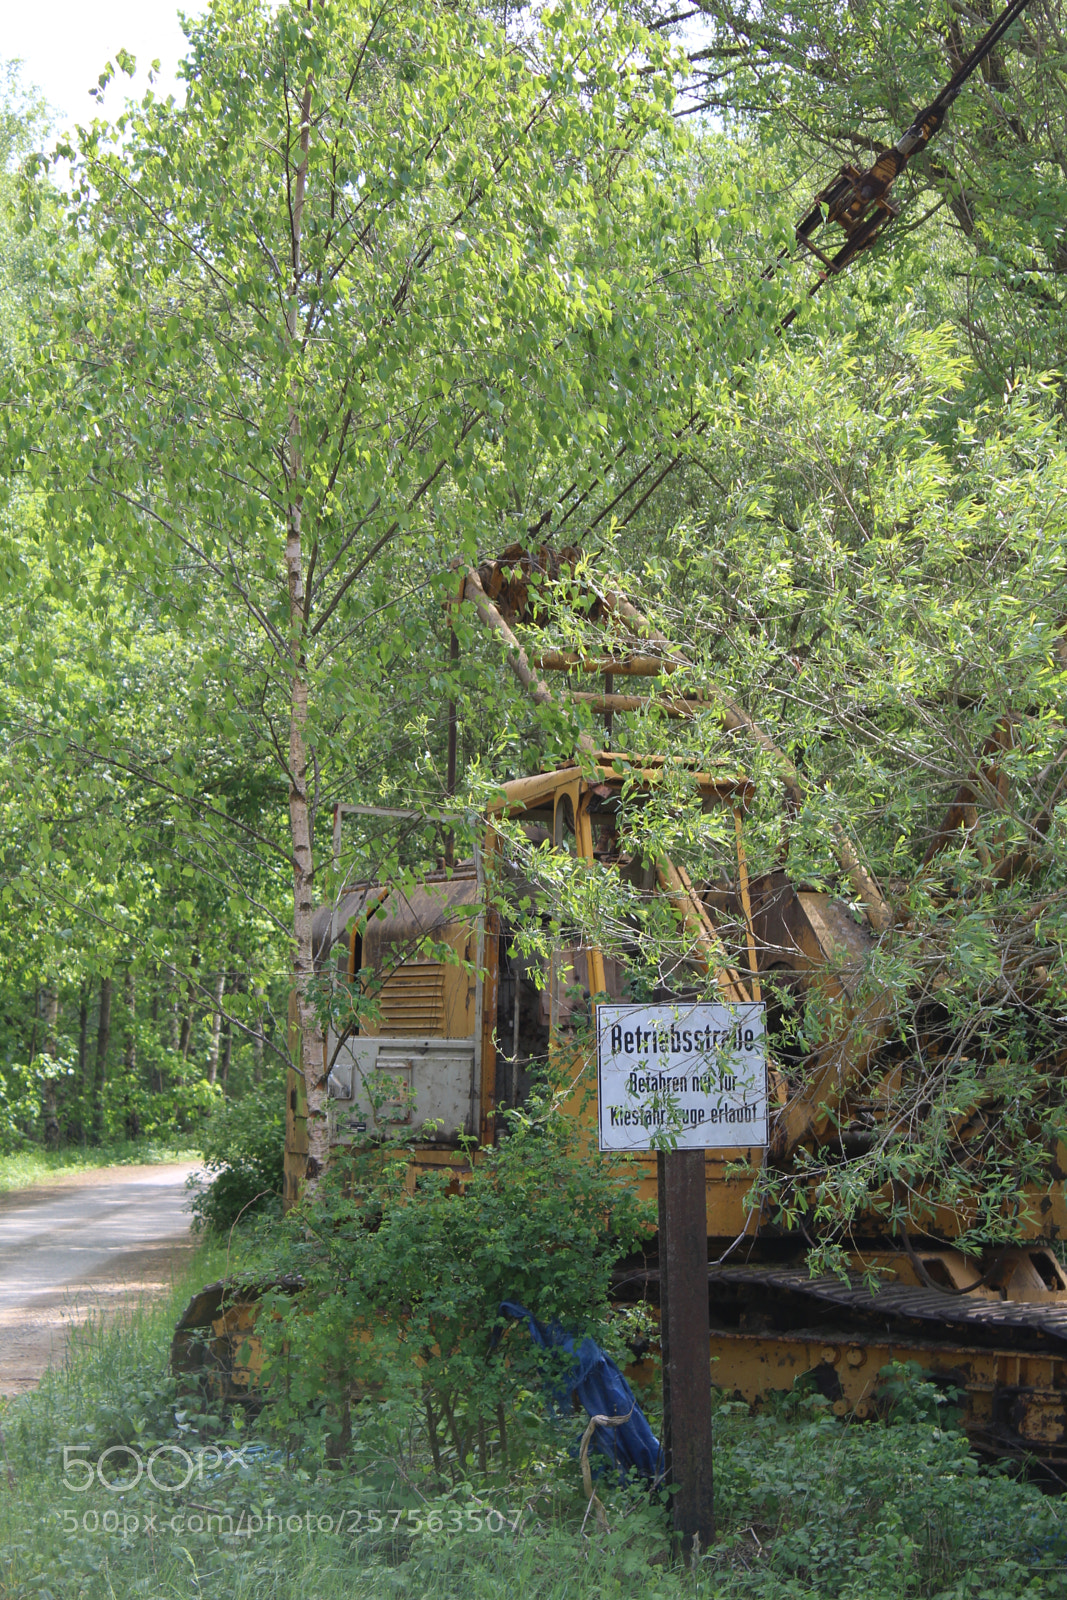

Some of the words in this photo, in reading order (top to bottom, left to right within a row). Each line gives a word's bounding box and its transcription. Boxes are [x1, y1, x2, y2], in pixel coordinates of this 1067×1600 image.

[630, 1072, 687, 1093] Befahren
[692, 1075, 712, 1092] nur
[610, 1105, 705, 1126] Kiesfahruge
[711, 1102, 757, 1124] erlaubt
